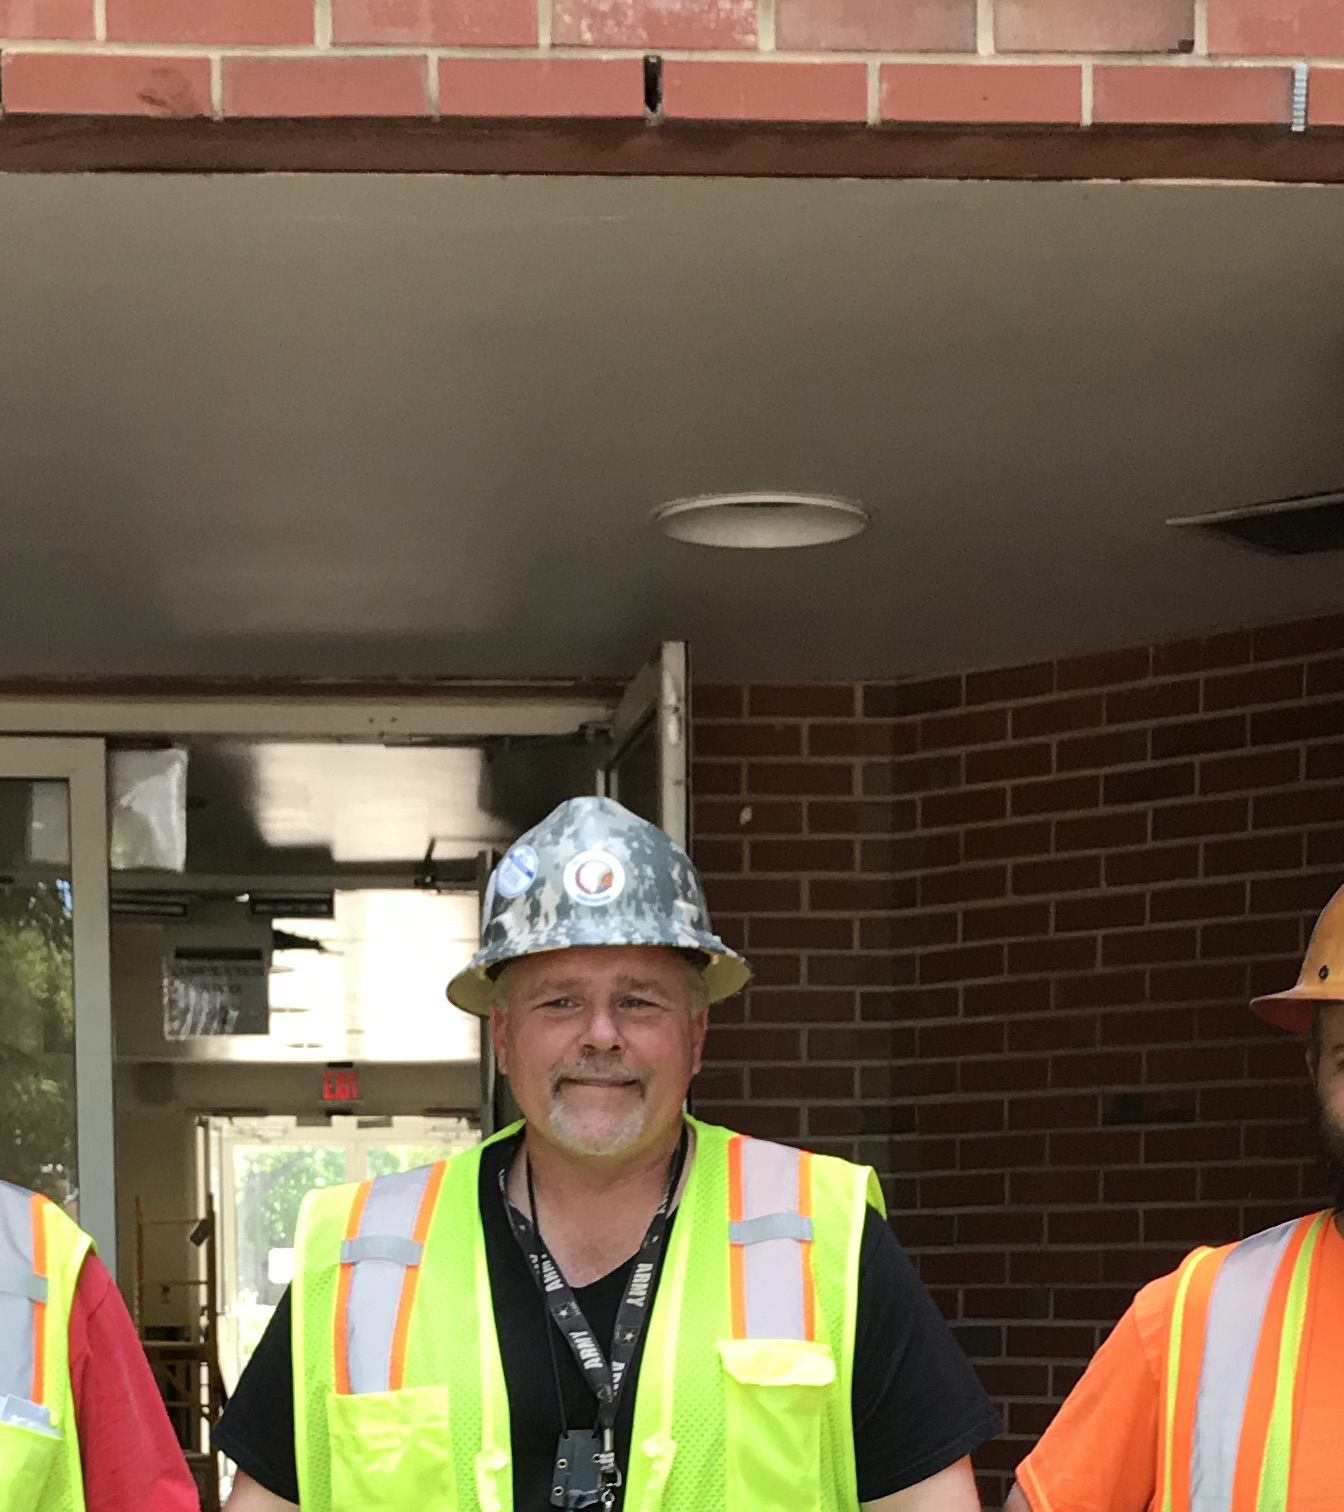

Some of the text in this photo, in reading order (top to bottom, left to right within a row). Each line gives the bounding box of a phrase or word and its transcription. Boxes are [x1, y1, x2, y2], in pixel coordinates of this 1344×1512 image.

[322, 1070, 360, 1100] EXIT
[540, 1253, 564, 1293] ARM
[625, 1263, 654, 1307] ARMY
[568, 1330, 604, 1370] ARMY
